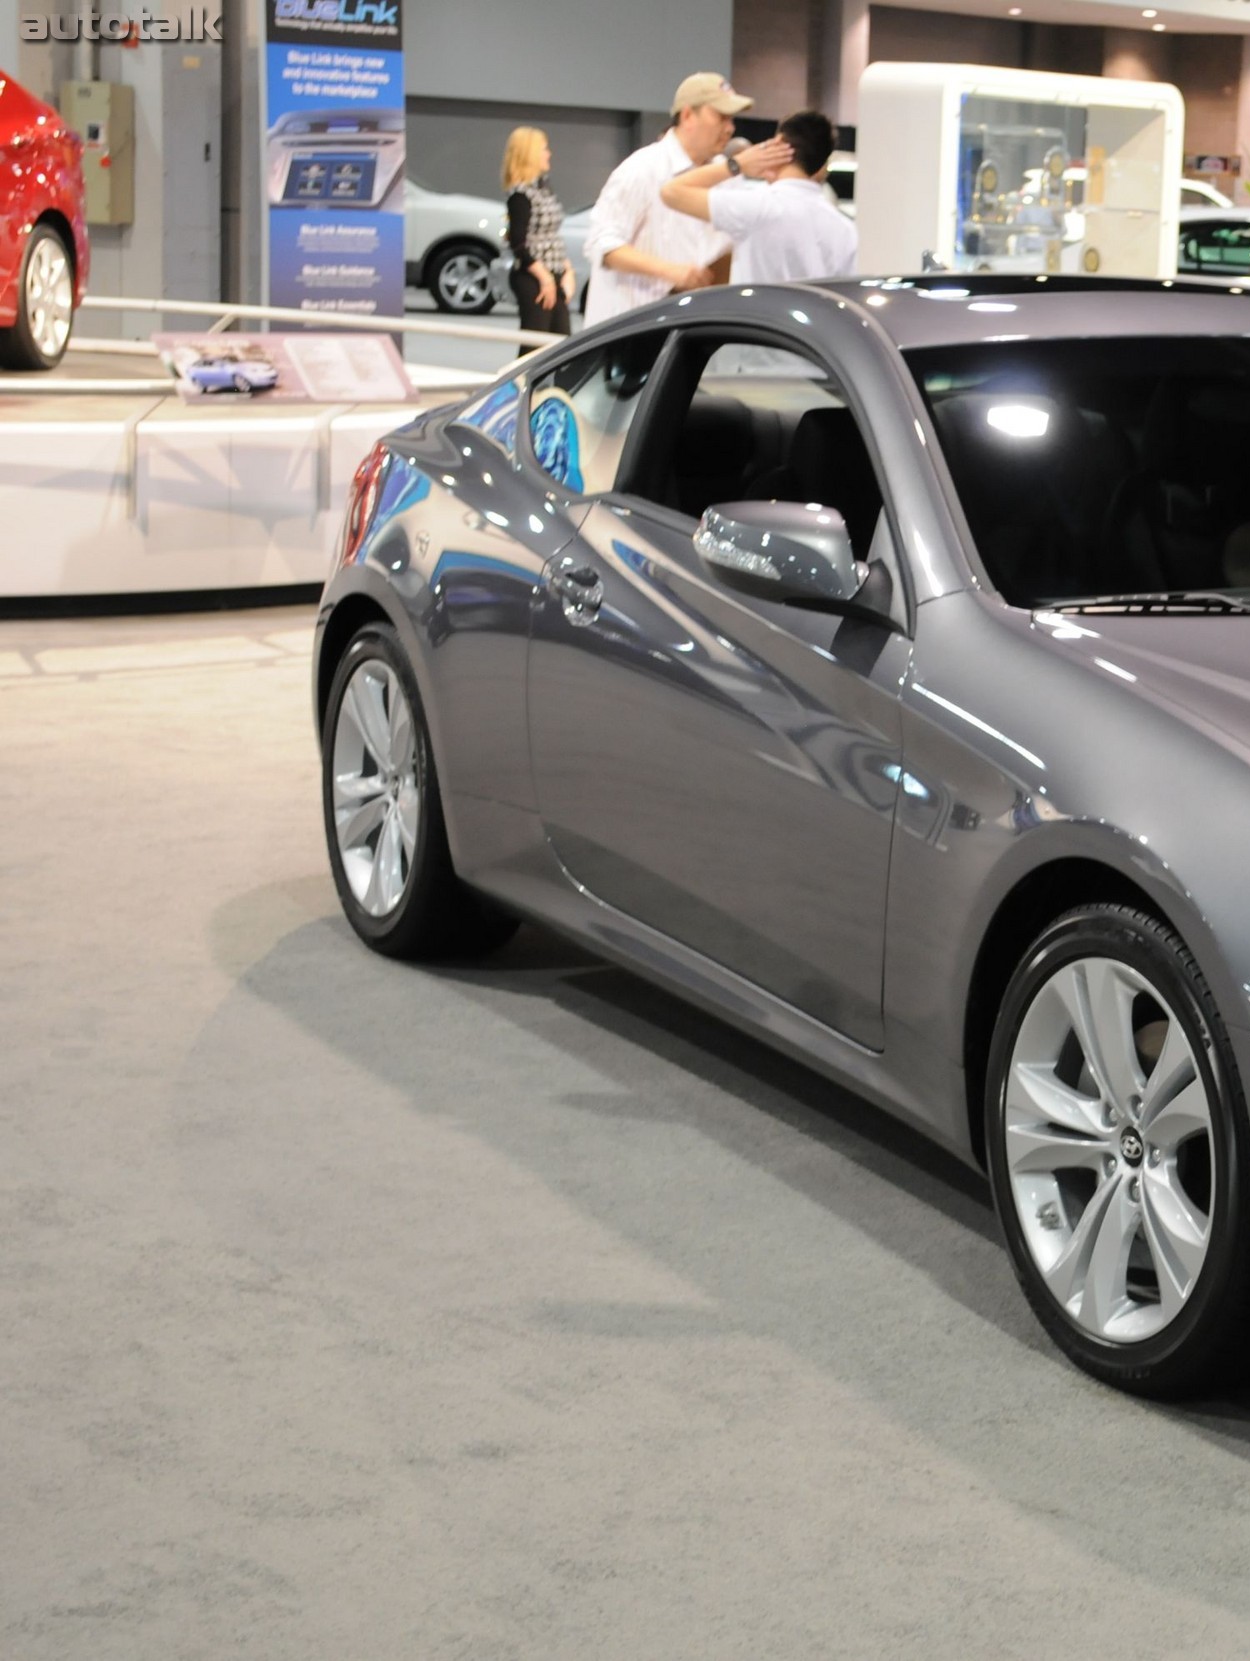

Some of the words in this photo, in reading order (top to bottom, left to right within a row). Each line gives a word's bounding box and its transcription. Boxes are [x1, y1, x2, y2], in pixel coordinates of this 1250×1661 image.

[287, 50, 310, 65] Blue
[311, 53, 332, 67] Link
[333, 54, 364, 71] brings
[364, 57, 385, 69] new
[282, 66, 302, 79] and
[302, 67, 350, 82] innovative
[350, 70, 390, 85] features
[291, 81, 303, 95] to
[303, 82, 320, 96] the
[320, 84, 379, 100] marketplace
